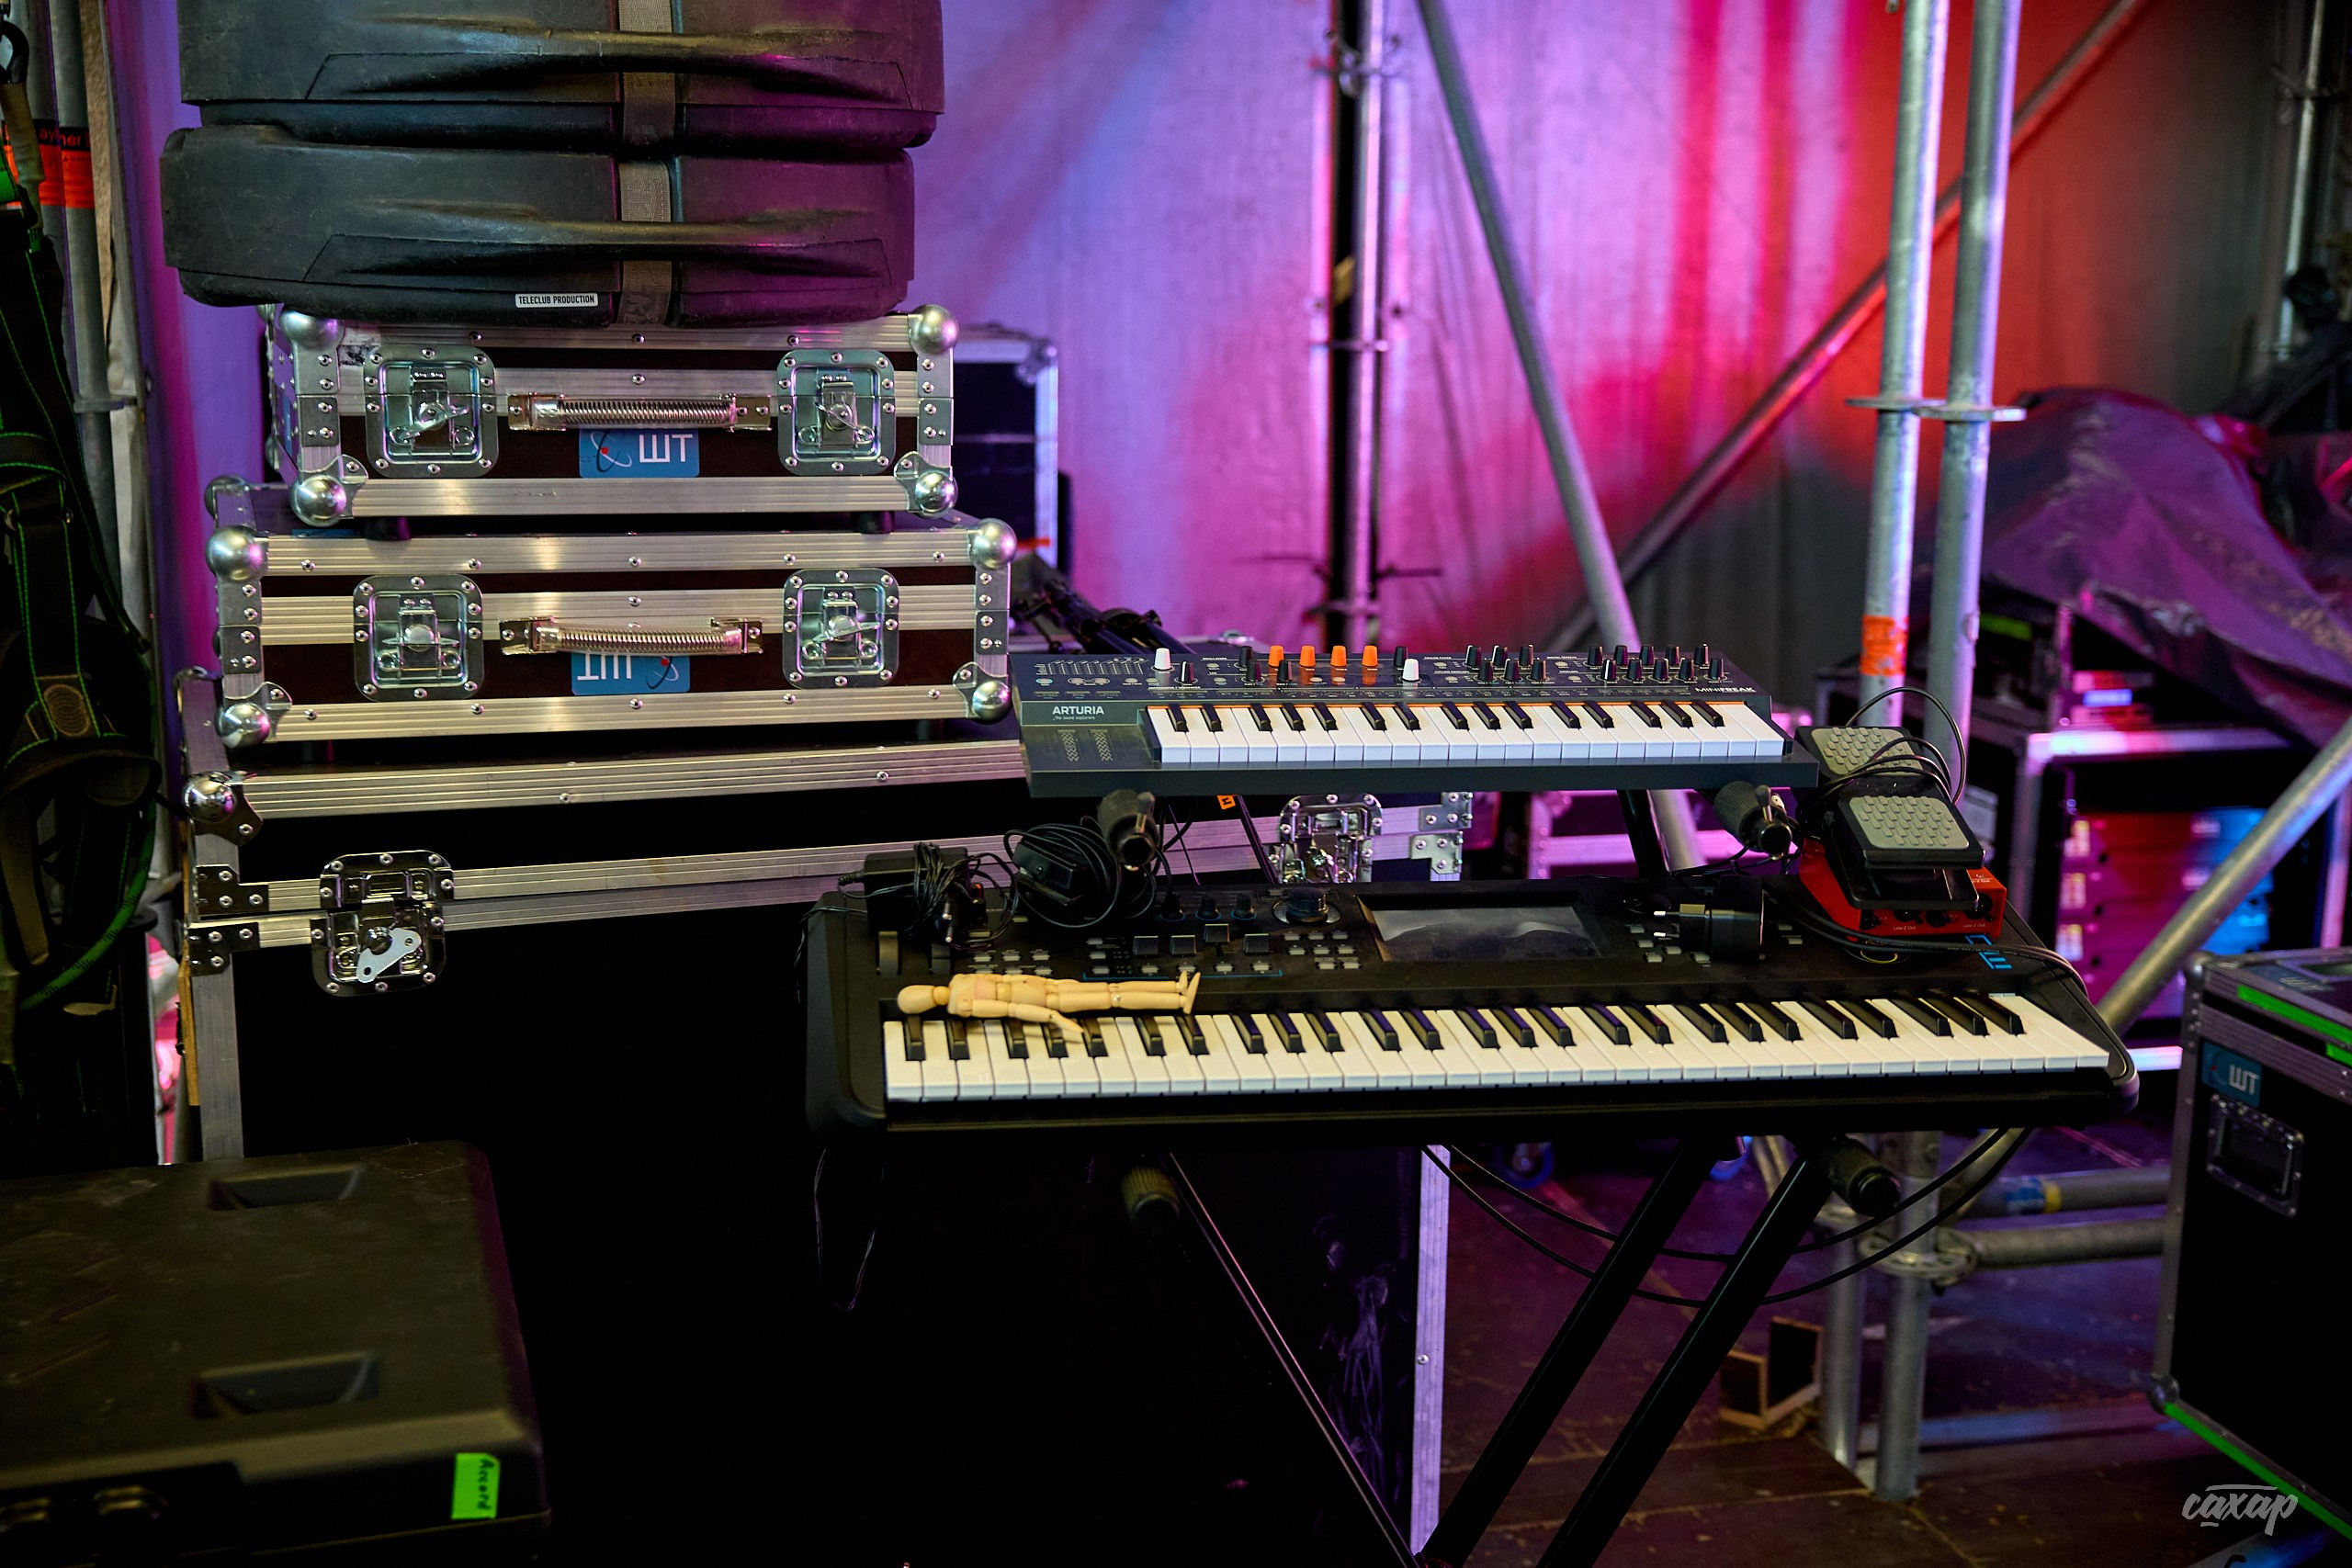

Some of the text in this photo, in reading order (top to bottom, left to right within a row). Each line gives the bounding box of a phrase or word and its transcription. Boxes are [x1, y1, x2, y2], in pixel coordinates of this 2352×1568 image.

[518, 295, 594, 304] TELECLUB PRODUCTION
[639, 434, 693, 463] ШТ
[1052, 705, 1104, 715] ARTURIA
[2228, 1064, 2260, 1096] ШТ
